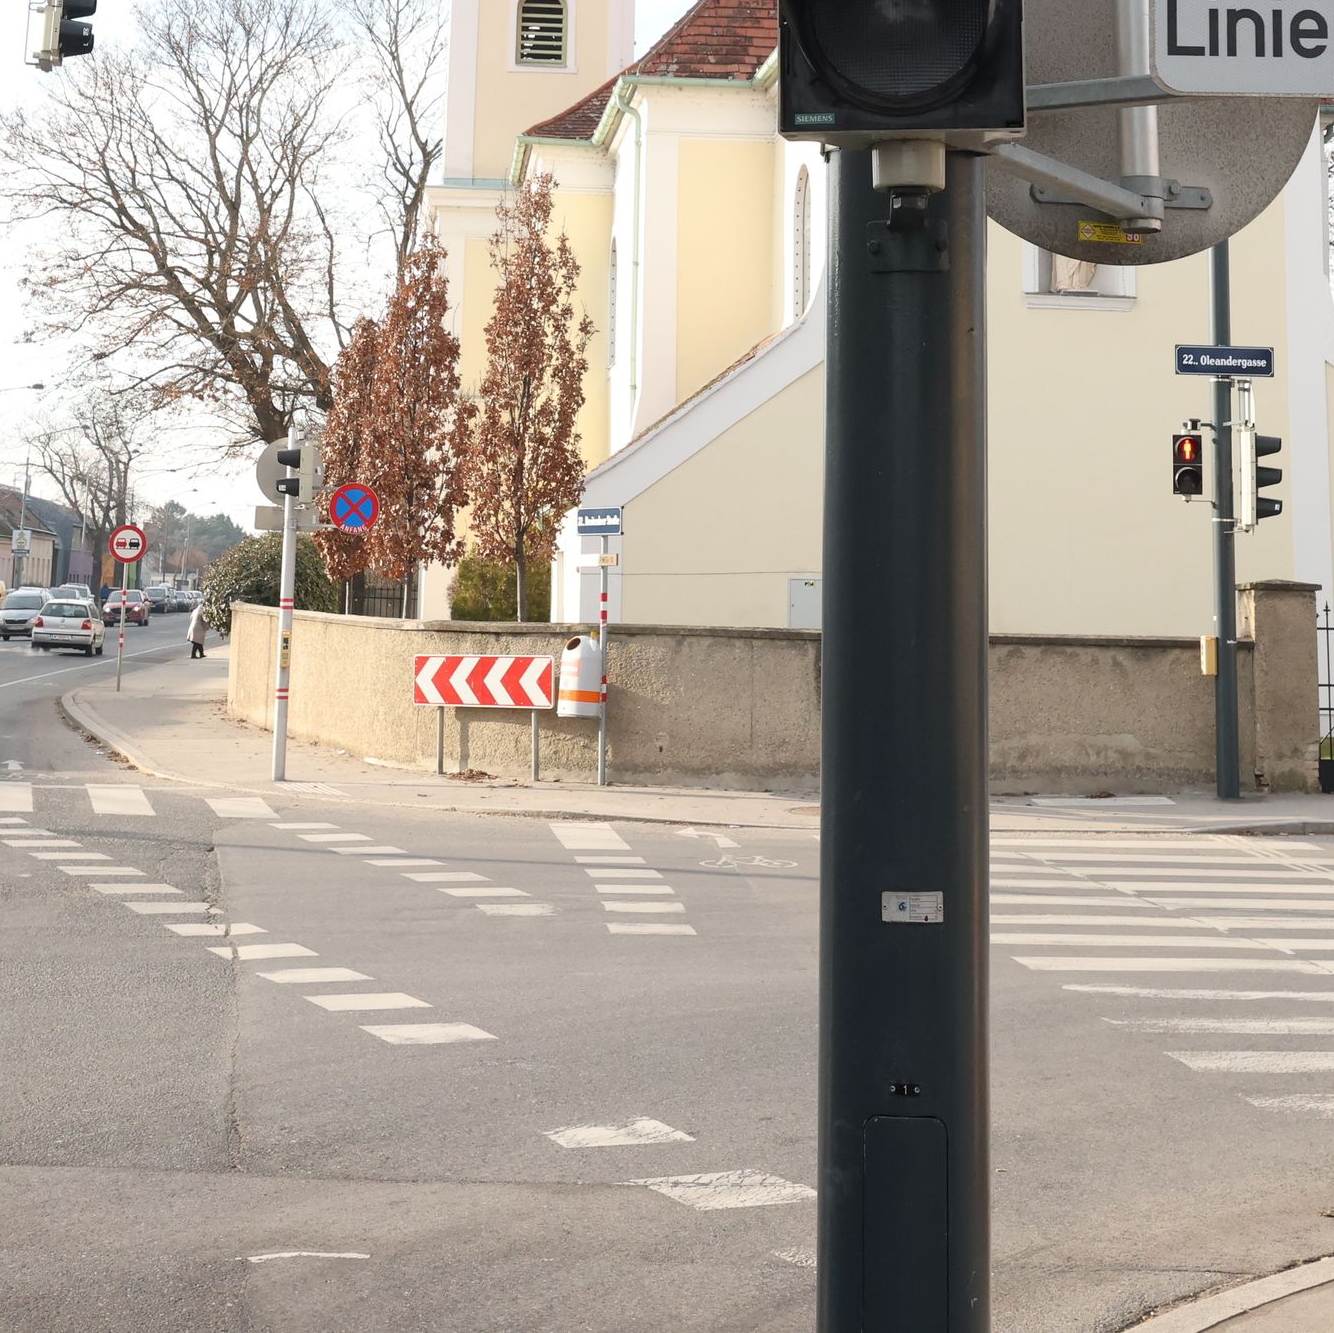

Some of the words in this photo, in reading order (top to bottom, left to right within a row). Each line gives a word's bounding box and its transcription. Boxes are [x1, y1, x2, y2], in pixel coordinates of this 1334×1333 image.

[796, 115, 833, 123] SIEMENS
[1200, 354, 1267, 369] Oleandergasse
[339, 523, 368, 534] ANFANG
